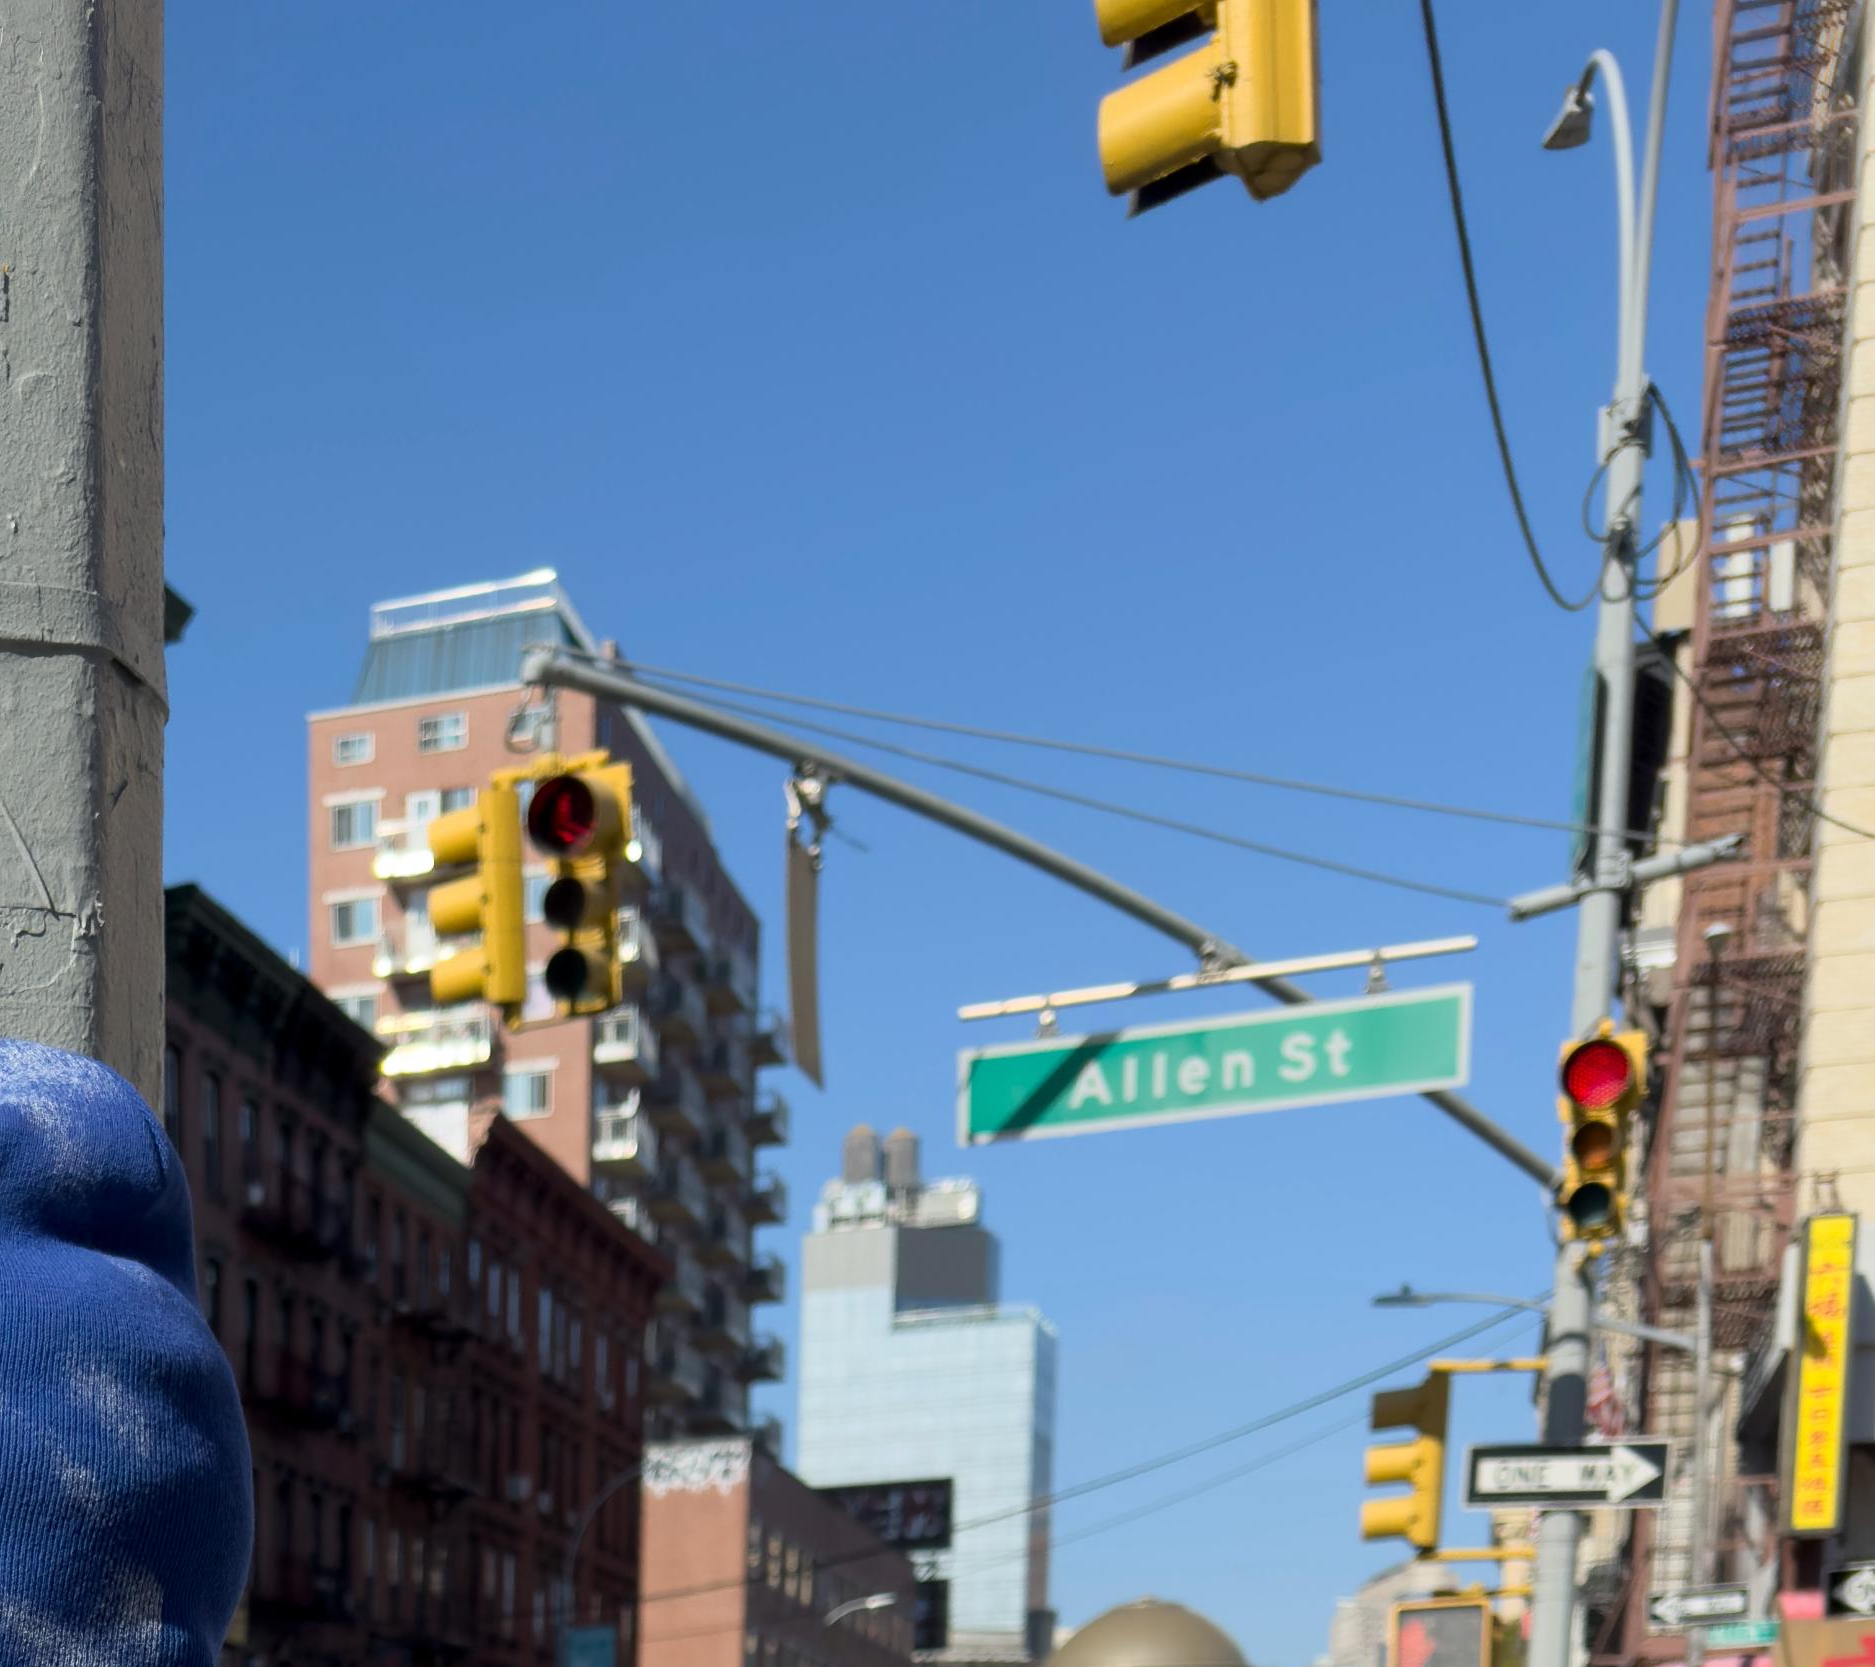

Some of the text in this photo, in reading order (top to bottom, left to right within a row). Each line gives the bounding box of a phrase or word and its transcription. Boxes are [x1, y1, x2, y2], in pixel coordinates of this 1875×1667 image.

[1070, 1030, 1352, 1109] Allen St
[1493, 1459, 1637, 1489] ONE WAY
